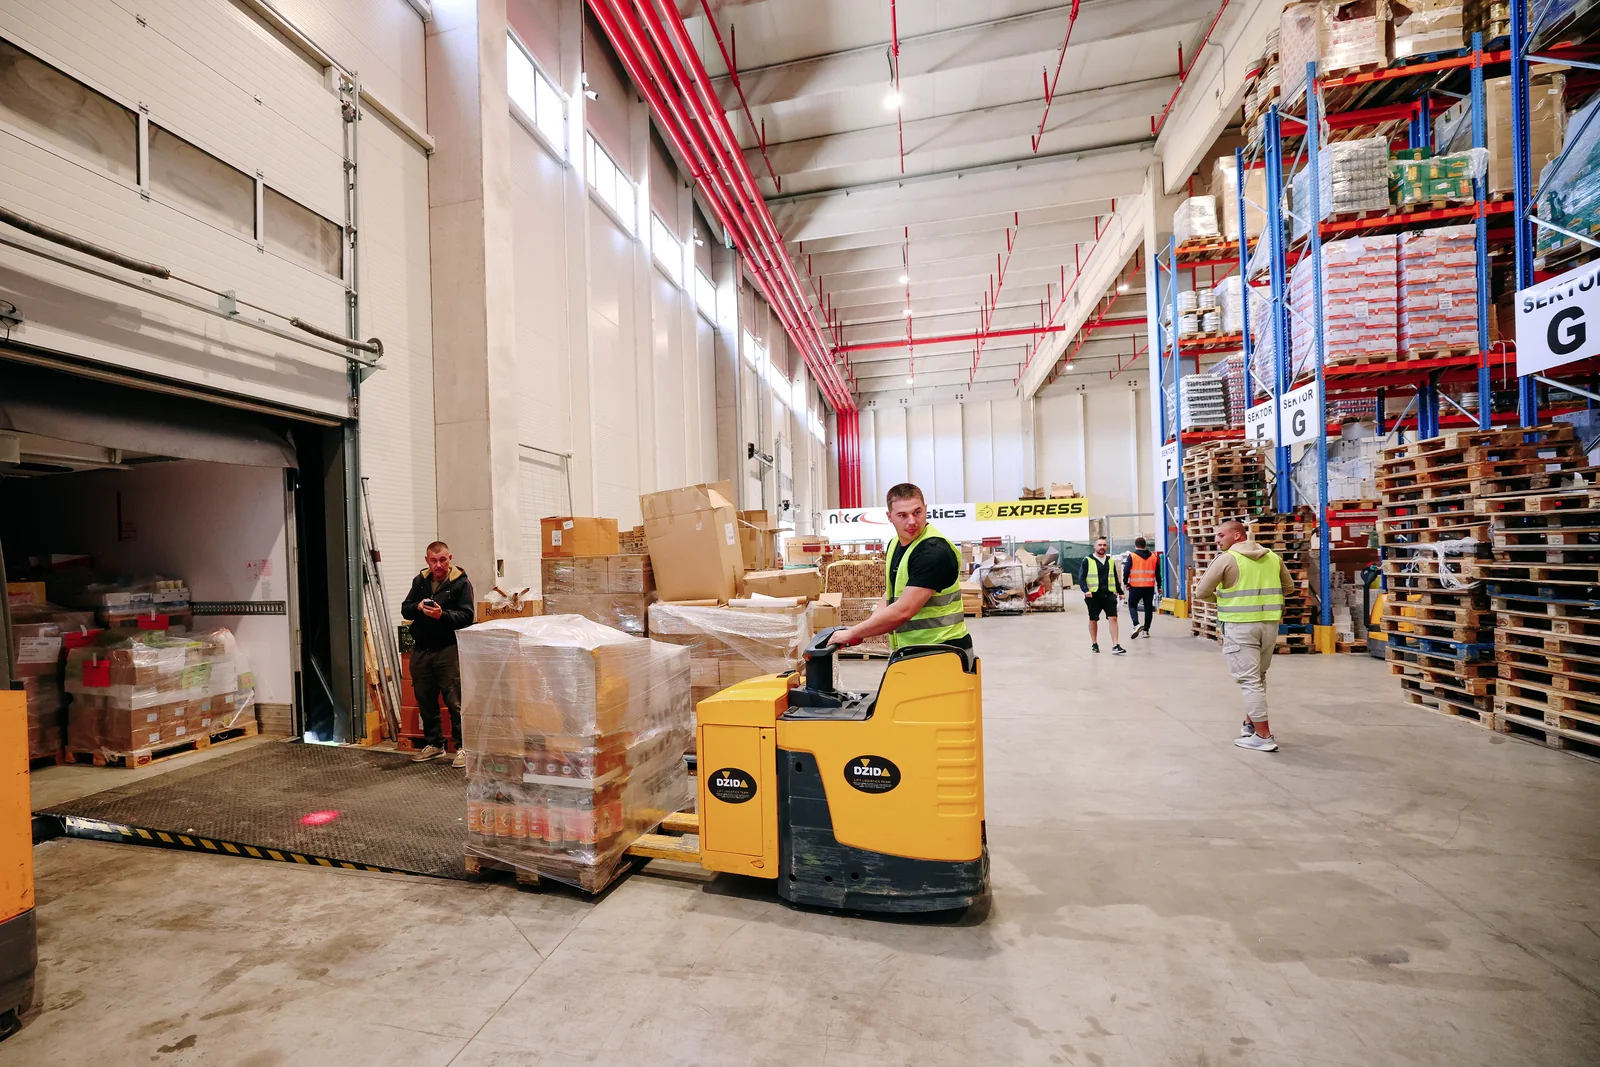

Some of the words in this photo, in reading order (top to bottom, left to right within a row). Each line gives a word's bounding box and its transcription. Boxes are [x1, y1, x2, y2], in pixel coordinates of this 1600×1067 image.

[1523, 268, 1600, 314] SEKTO
[1547, 306, 1586, 355] G
[1283, 389, 1314, 409] SEKTOR
[1247, 405, 1273, 423] SEKTOR
[1292, 409, 1306, 437] G
[1166, 458, 1171, 477] F
[997, 503, 1083, 517] EXPRESS
